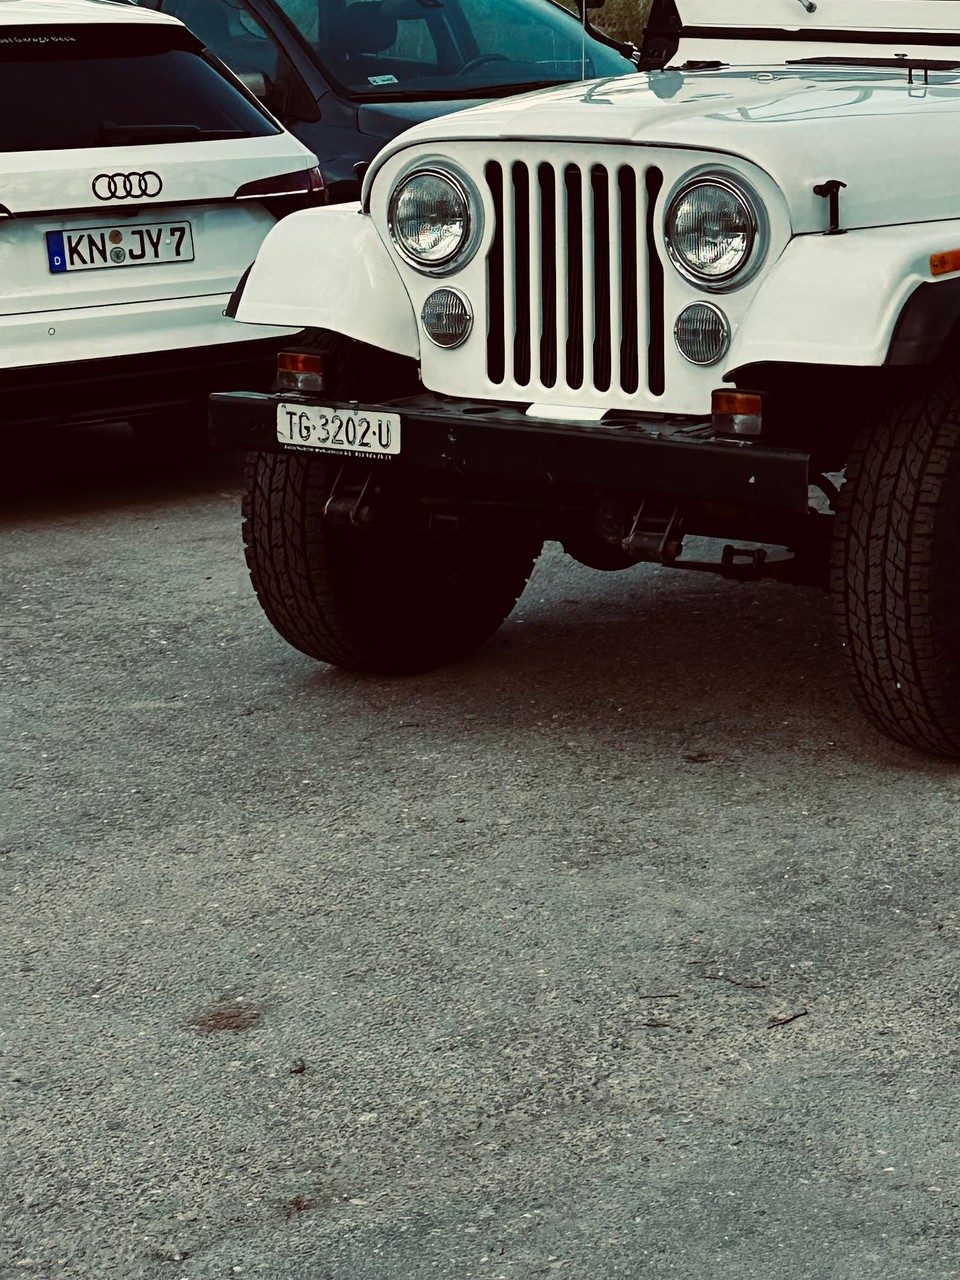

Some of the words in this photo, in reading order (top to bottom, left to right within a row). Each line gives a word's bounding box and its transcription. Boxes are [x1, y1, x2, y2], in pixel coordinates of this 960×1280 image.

[66, 232, 108, 266] KN
[128, 228, 163, 260] JY
[169, 226, 186, 257] 7
[54, 256, 61, 266] D
